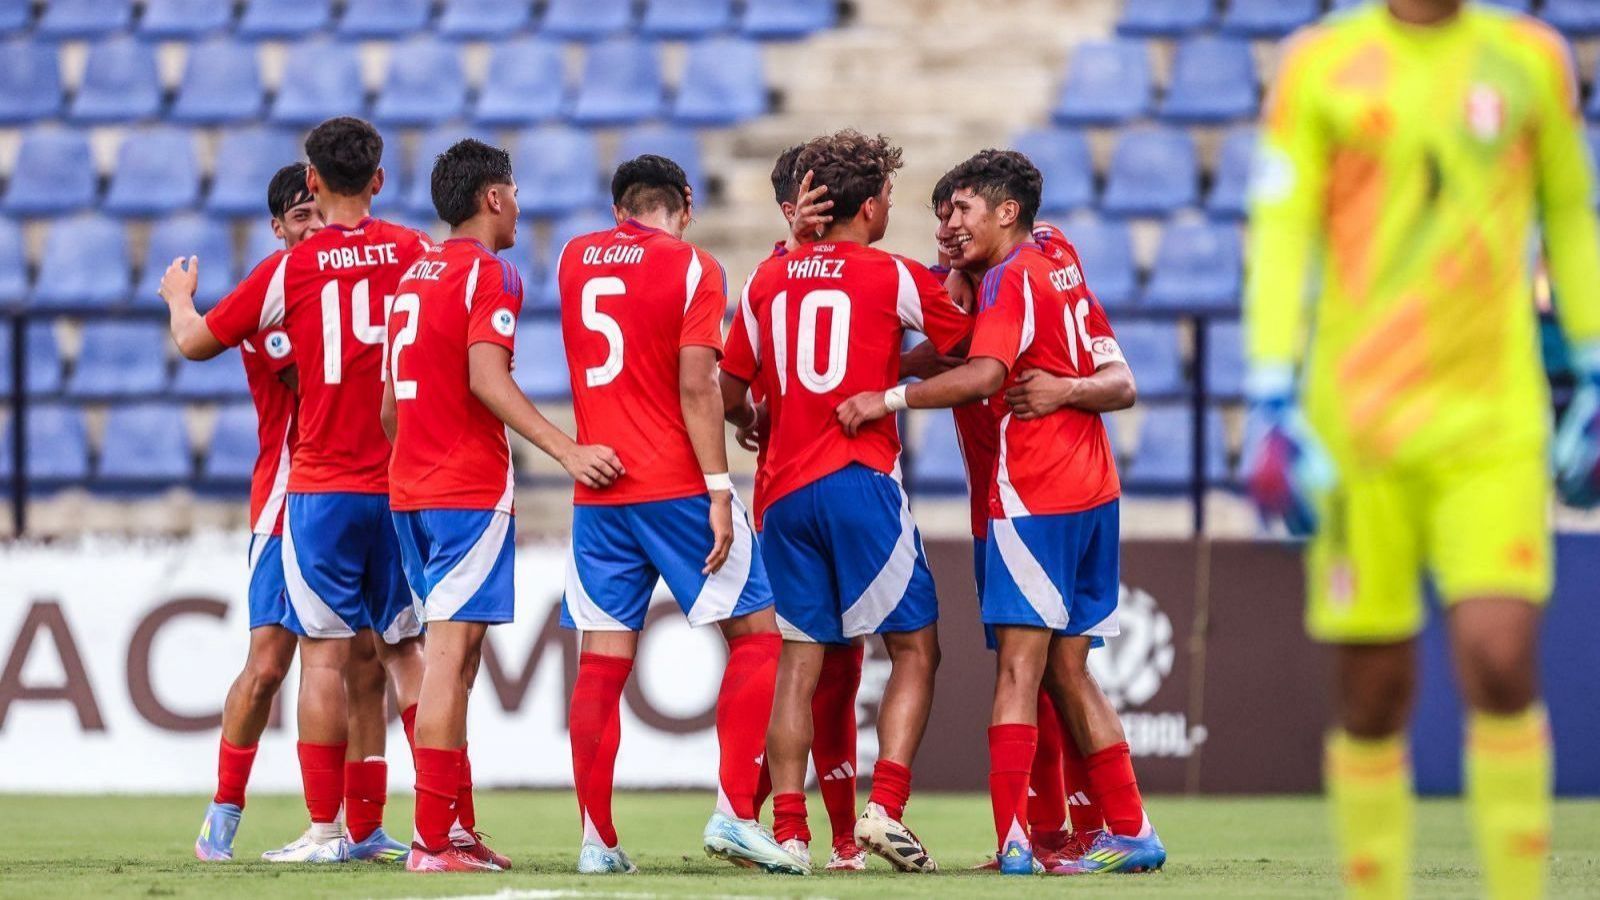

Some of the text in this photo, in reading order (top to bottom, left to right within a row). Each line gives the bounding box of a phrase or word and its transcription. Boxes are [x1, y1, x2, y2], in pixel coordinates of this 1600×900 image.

[317, 242, 399, 271] POBLETE
[787, 254, 846, 279] YÁÑEZ
[320, 278, 394, 385] 14
[389, 292, 420, 400] 2
[581, 275, 627, 388] 5
[771, 289, 852, 395] 10
